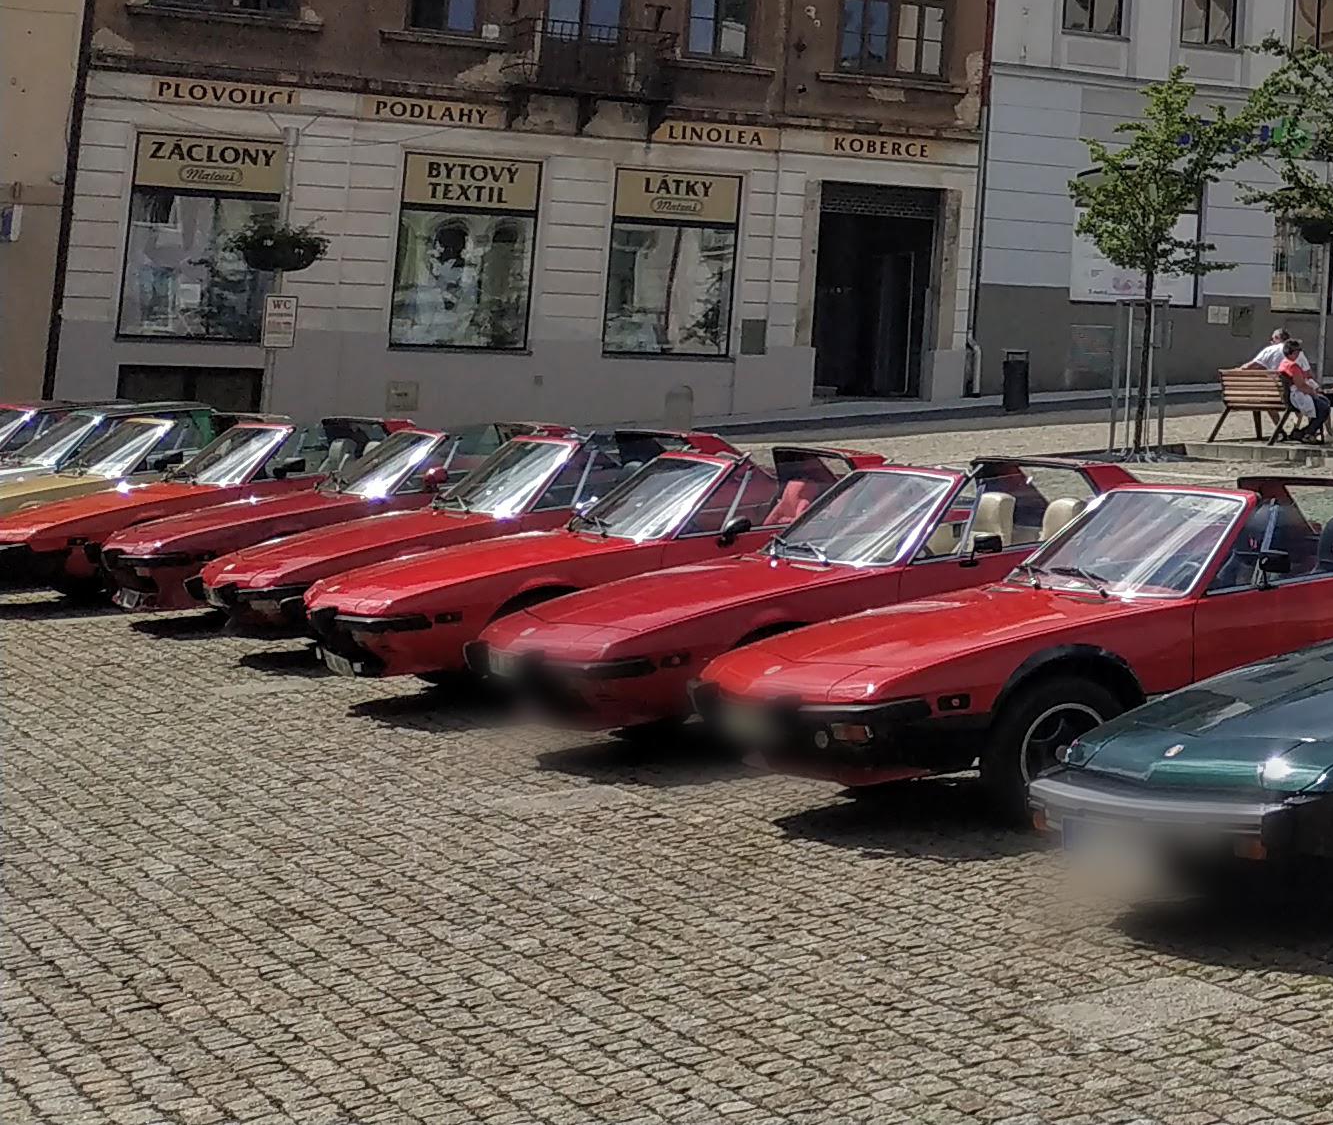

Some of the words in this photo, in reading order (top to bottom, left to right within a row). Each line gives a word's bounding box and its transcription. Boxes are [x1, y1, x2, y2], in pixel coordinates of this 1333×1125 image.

[158, 81, 295, 105] PLOVOUCÍ
[375, 100, 488, 124] PODLAHY
[668, 125, 763, 146] LINOLEA
[149, 139, 277, 167] ZÁCLONY
[833, 137, 929, 158] KOBERCE
[427, 161, 519, 184] BYTOVÝ
[428, 182, 508, 204] TEXTIL
[644, 175, 713, 197] LÁTKY
[272, 300, 292, 310] WC
